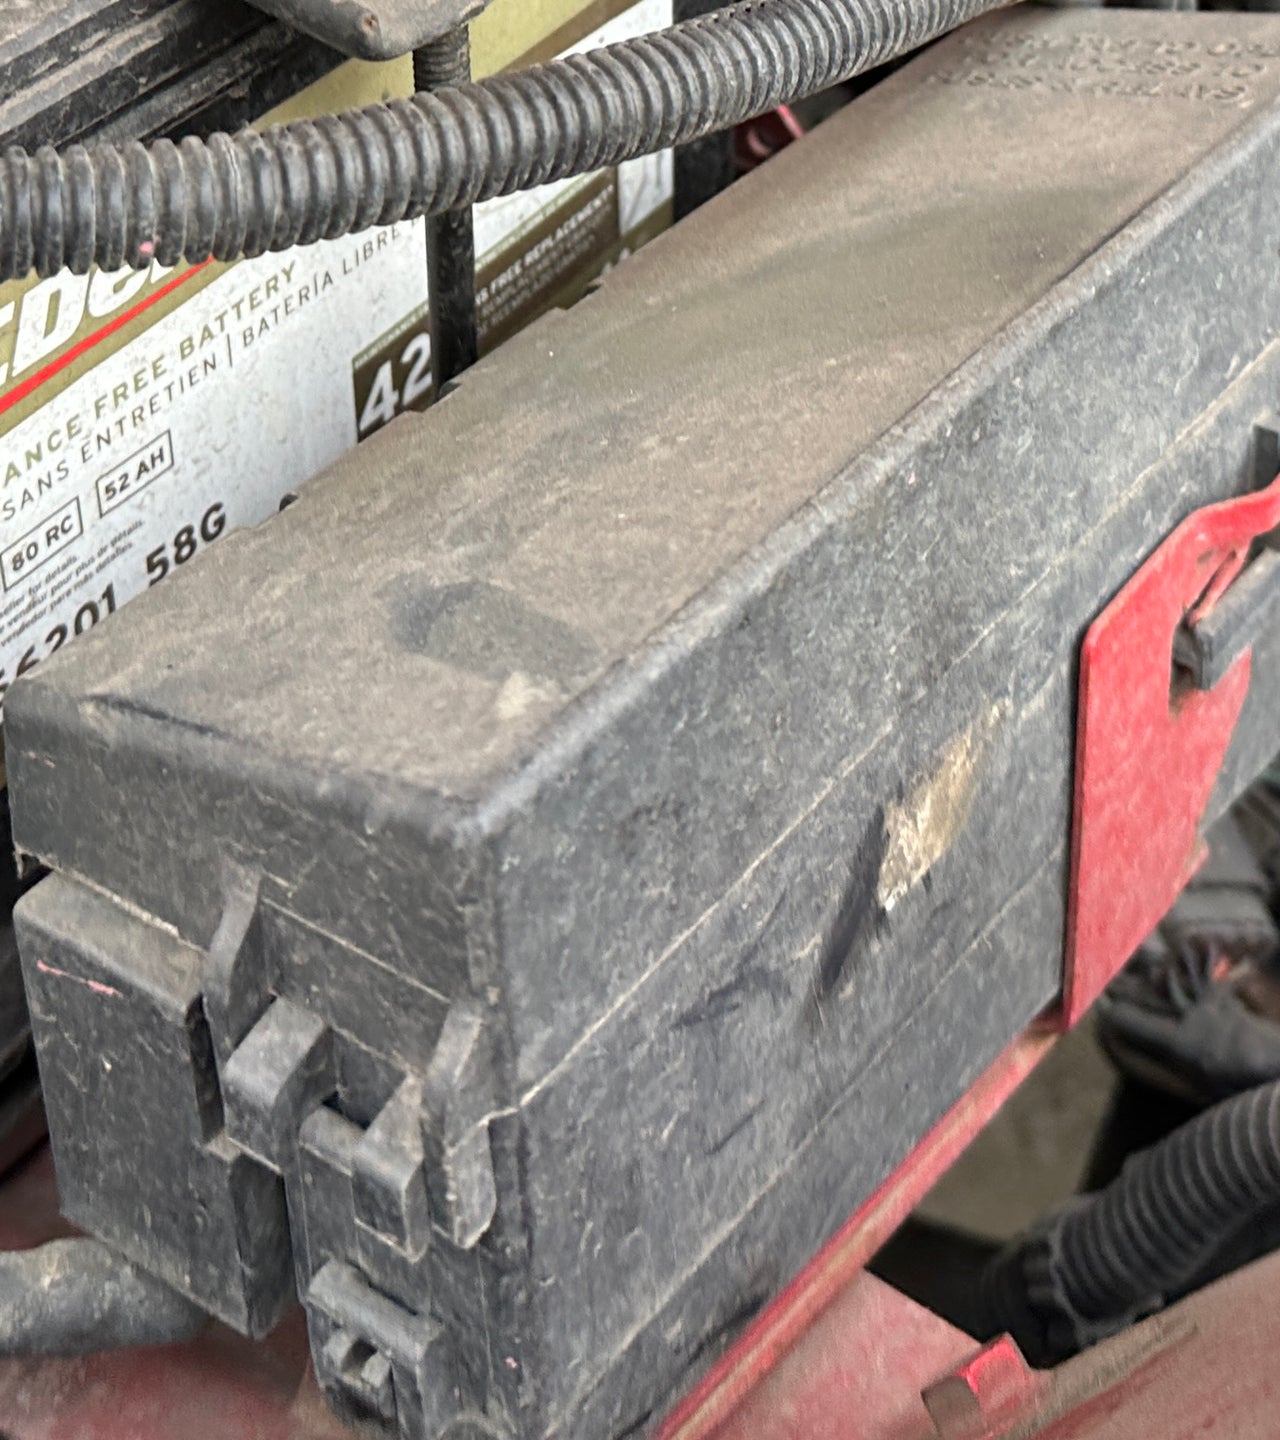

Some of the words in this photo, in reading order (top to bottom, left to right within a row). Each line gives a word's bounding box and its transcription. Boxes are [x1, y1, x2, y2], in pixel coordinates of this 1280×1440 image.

[490, 259, 522, 294] FREE
[3, 460, 70, 521] SANS
[81, 353, 217, 463] ENTRETIEN
[242, 270, 334, 348] BATERÍA
[342, 225, 402, 276] LIBRE
[94, 355, 168, 418] FREE
[179, 260, 296, 361] BATTERY
[360, 332, 432, 431] 42
[104, 473, 130, 500] 52
[136, 446, 165, 480] AH
[12, 542, 39, 571] 80
[46, 515, 74, 547] RC
[146, 502, 227, 587] 58G
